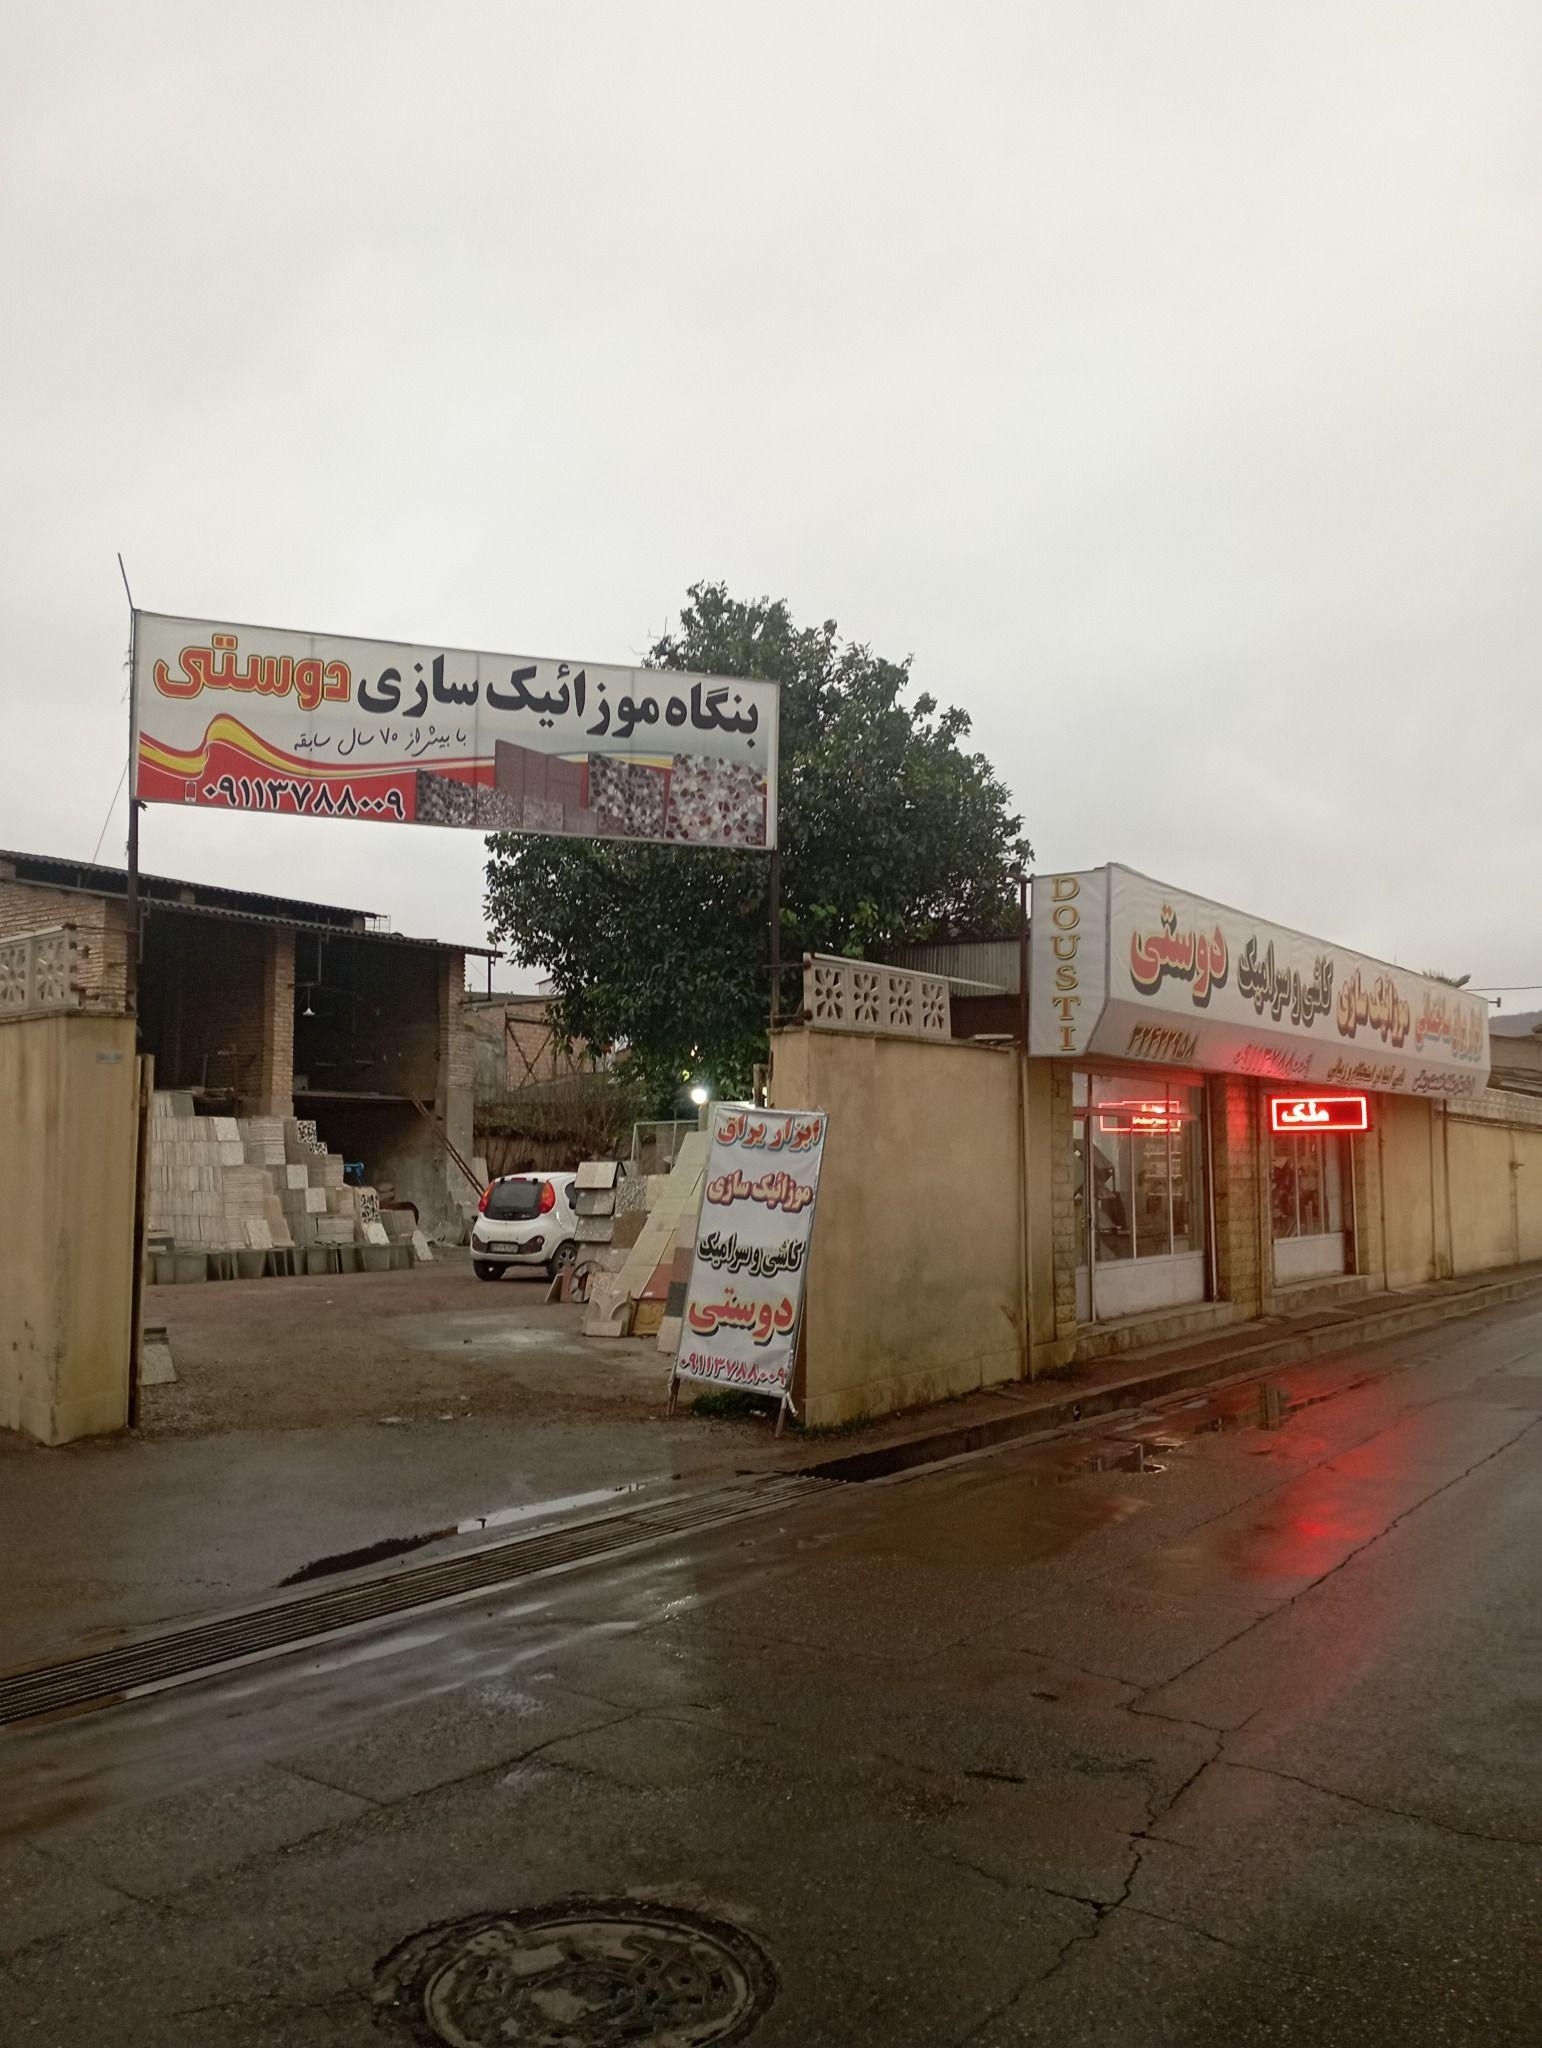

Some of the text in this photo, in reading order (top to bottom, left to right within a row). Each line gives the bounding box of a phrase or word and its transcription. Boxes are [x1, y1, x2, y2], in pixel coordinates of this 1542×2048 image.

[153, 633, 352, 712] دوستی
[358, 654, 479, 717] سازی
[294, 733, 331, 751] سابقه
[337, 728, 375, 756] سال
[379, 728, 398, 742] ۷۰
[456, 728, 467, 746] با
[666, 684, 759, 748] بنگاه
[202, 774, 406, 820] ۰۹۱۱۳۷۸۸۰۰۹
[1050, 876, 1081, 1051] DOUSTI
[1130, 903, 1229, 1009] دوستی
[1238, 934, 1292, 1022] سرامیک
[1291, 969, 1302, 1026] و
[1300, 954, 1334, 1028] کاشی
[716, 1112, 822, 1151] ابزار یراق
[706, 1169, 752, 1206] سازی
[697, 1230, 806, 1278] کاشی و سرامیک
[688, 1287, 796, 1347] دوستی
[680, 1351, 787, 1388] ۰۹۱۱۳۷۸۸۰۰۹
